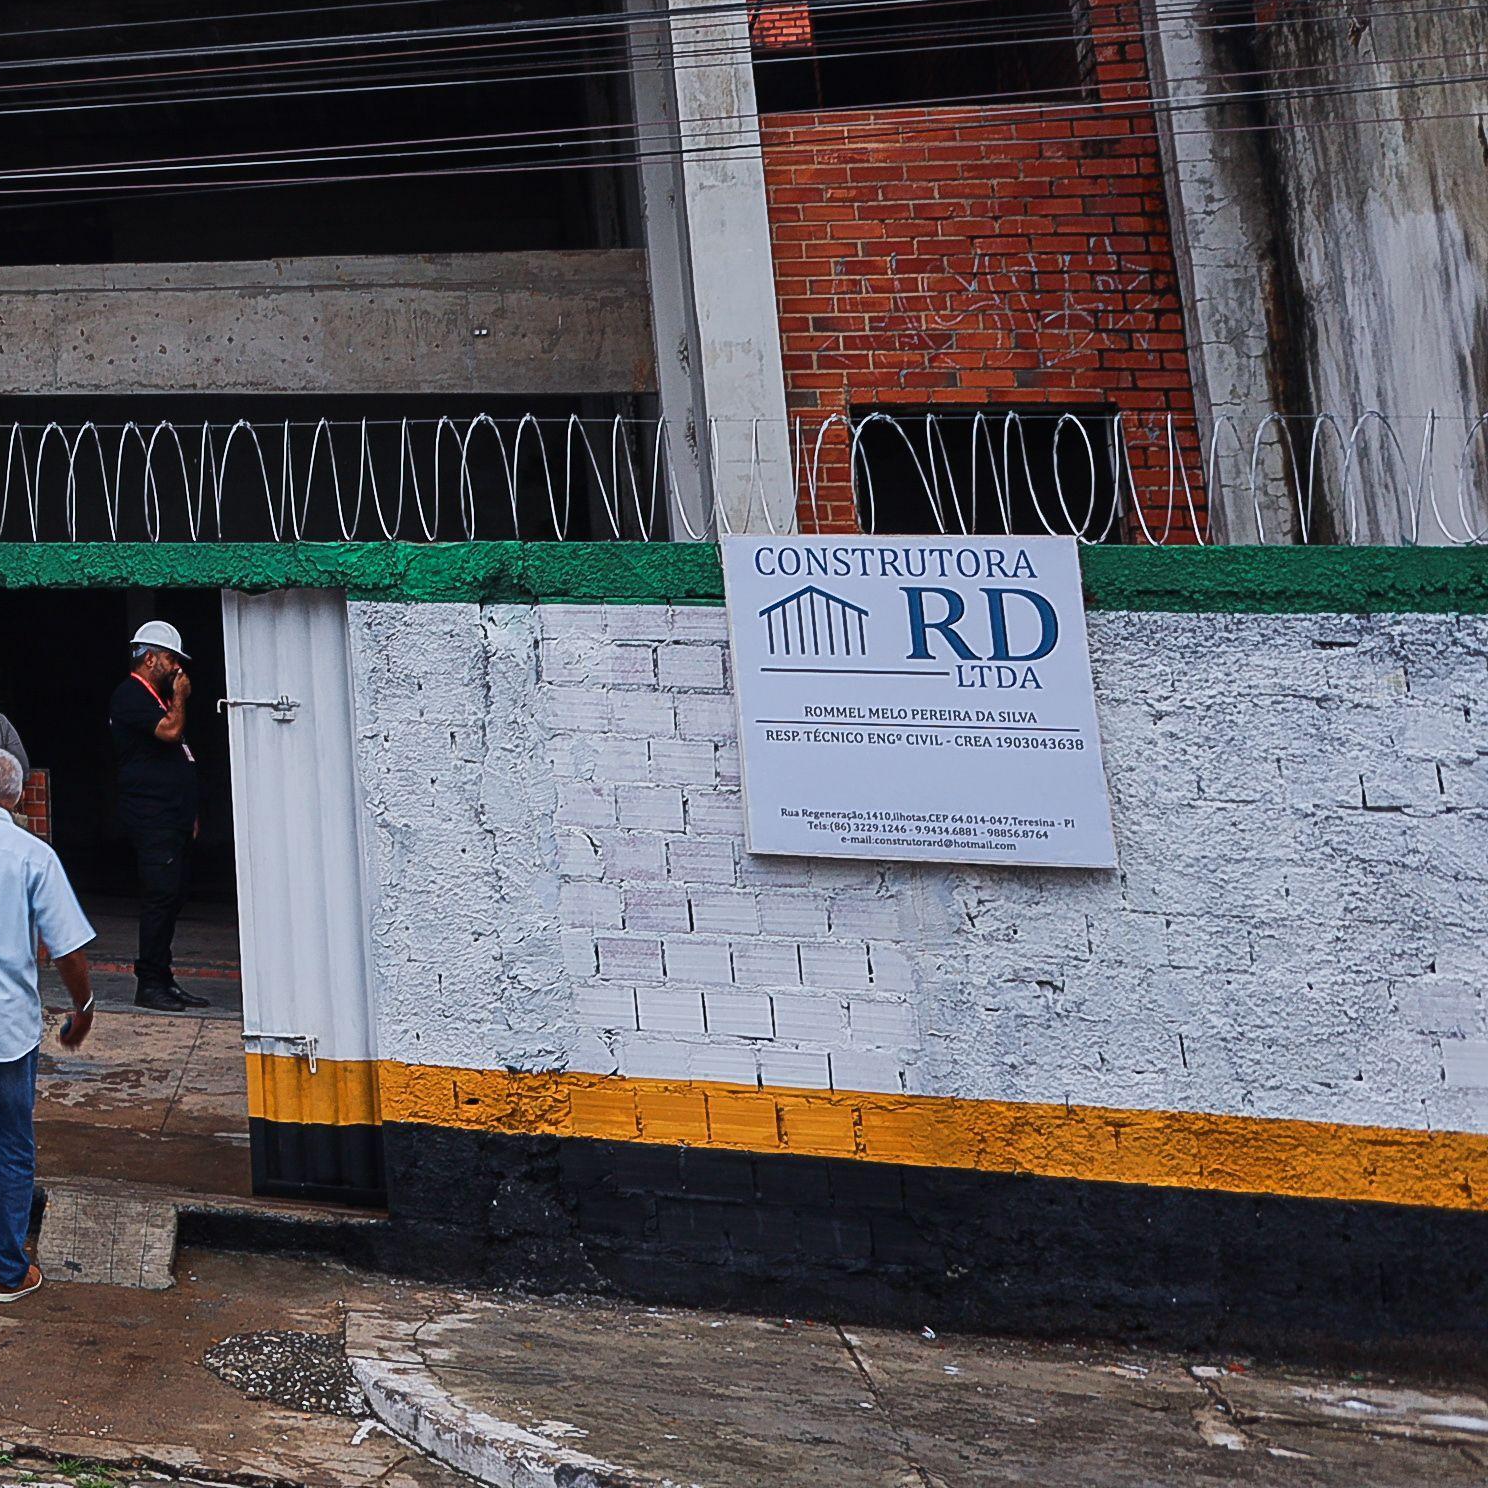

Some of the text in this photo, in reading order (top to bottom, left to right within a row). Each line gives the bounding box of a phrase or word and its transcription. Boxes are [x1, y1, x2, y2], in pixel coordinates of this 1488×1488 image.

[754, 546, 1039, 579] CONSTRUTORA
[899, 586, 1060, 663] RD
[955, 664, 1044, 690] LTDA
[804, 705, 1038, 724] ROMMEL MELO PEREIRA DA SILVA
[765, 729, 801, 743] RESP.
[803, 727, 864, 744] TÉCNICO
[905, 733, 943, 747] CIVIL
[954, 735, 992, 748] CREA
[996, 736, 1085, 752] 1903043638
[780, 807, 799, 817] Rua
[853, 823, 907, 834] 3229.1246
